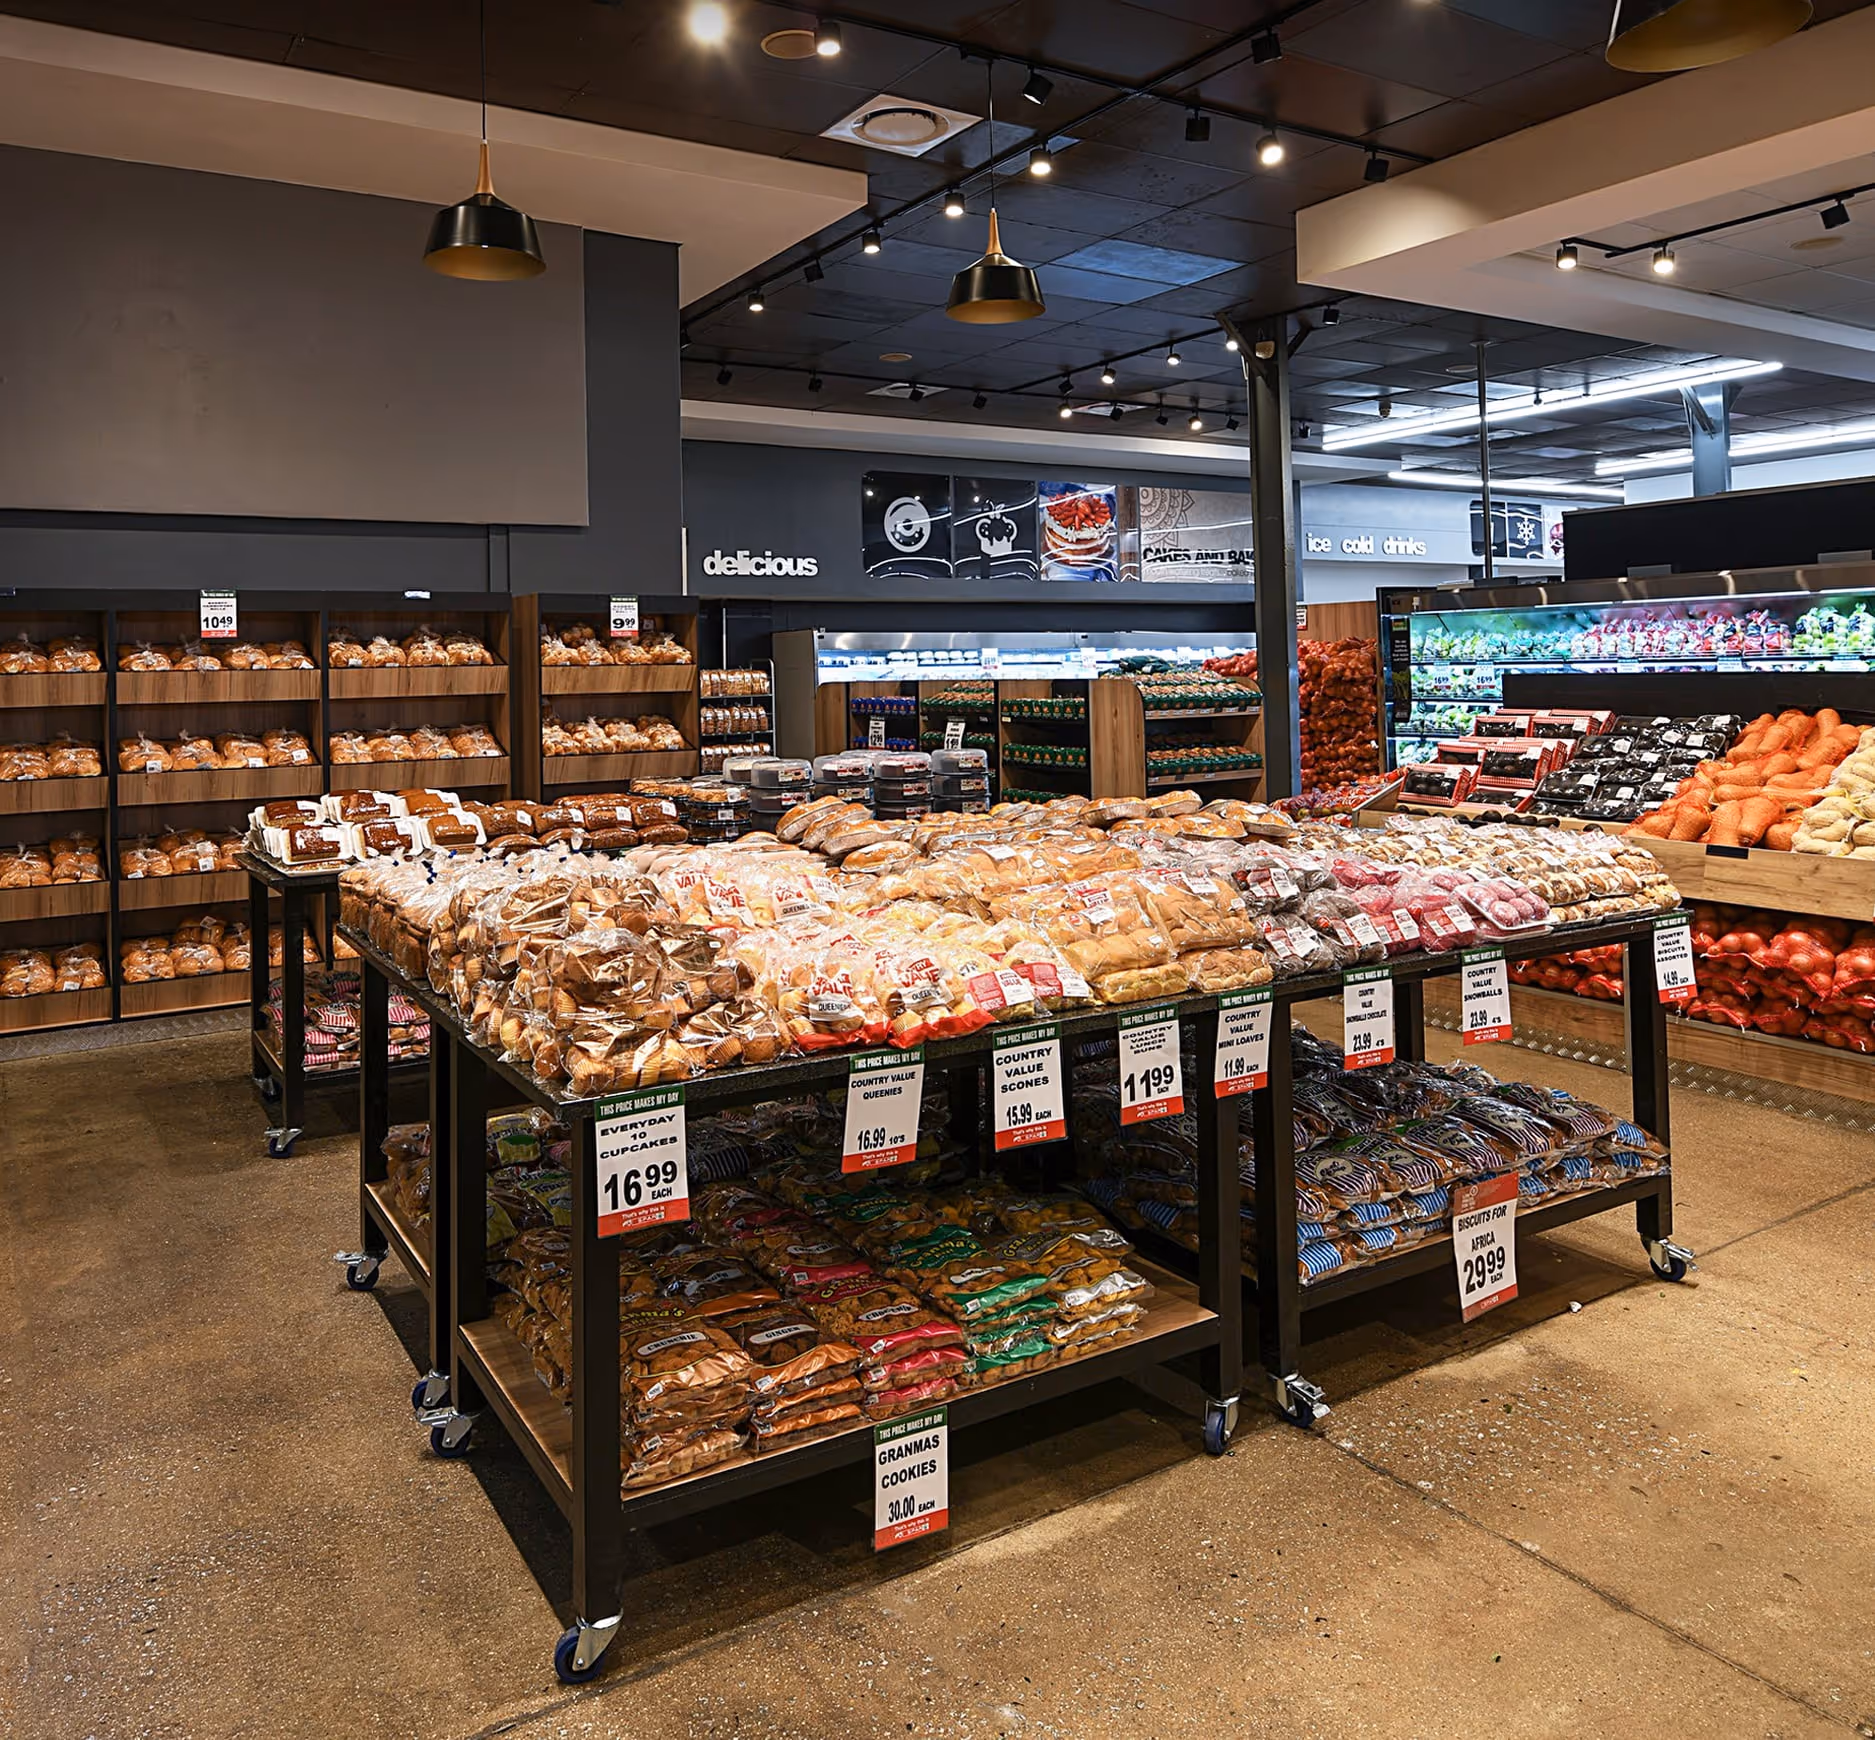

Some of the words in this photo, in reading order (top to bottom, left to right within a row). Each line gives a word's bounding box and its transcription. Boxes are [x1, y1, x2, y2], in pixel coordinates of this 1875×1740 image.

[1306, 533, 1332, 553] ice
[1341, 536, 1374, 554] cold
[1383, 536, 1426, 555] drinks
[703, 550, 818, 576] delicious
[1143, 548, 1191, 564] CAKES
[1195, 549, 1224, 564] AND
[1657, 931, 1684, 940] COUNTRY
[1467, 967, 1496, 977] COUNTRY
[1472, 979, 1492, 988] VALUE
[1464, 988, 1502, 1001] SNOWBALLS
[1225, 1010, 1261, 1022] COUNTRY
[1122, 1025, 1173, 1039] COUNTRY
[1230, 1023, 1254, 1034] VALUE
[1130, 1038, 1166, 1050] LUNCH
[1131, 1033, 1165, 1043] VALUE
[1219, 1040, 1234, 1049] MINI
[1236, 1033, 1264, 1045] LOAVES
[996, 1047, 1052, 1066] COUNTRY
[1134, 1045, 1162, 1054] BUNS
[867, 1056, 882, 1068] PRICE
[1225, 1057, 1244, 1077] 11.99
[1005, 1063, 1043, 1078] VALUE
[851, 1075, 889, 1088] COUNTRY
[891, 1072, 916, 1082] VALUE
[1001, 1076, 1049, 1093] SCONES
[863, 1087, 902, 1099] QUEENIES
[600, 1106, 614, 1116] THIS
[616, 1101, 633, 1113] PRICE
[634, 1097, 655, 1110] MAKES
[656, 1094, 666, 1105] MY
[668, 1092, 679, 1102] DAY
[1007, 1103, 1031, 1126] 15.99
[1036, 1110, 1051, 1120] EACH
[601, 1114, 675, 1136] EVERYDAY
[631, 1132, 647, 1140] 10
[858, 1127, 886, 1151] 16.99
[600, 1136, 677, 1159] CUPCAKES
[652, 1187, 672, 1200] EACH
[1458, 1210, 1491, 1232] BISCUITS
[1492, 1205, 1507, 1220] FOR
[1472, 1231, 1496, 1252] AFRICA
[1491, 1272, 1503, 1284] EACH
[765, 1326, 801, 1339] GINGER
[647, 1334, 698, 1352] CRUNCHIE
[880, 1428, 891, 1440] THIS
[892, 1424, 905, 1438] PRICE
[907, 1419, 923, 1432] MAKES
[925, 1416, 933, 1427] MY
[934, 1413, 943, 1424] DAY
[879, 1435, 940, 1466] GRANMAS
[881, 1459, 937, 1489] COOKIES
[888, 1495, 915, 1523] 30.00
[918, 1500, 935, 1513] EACH
